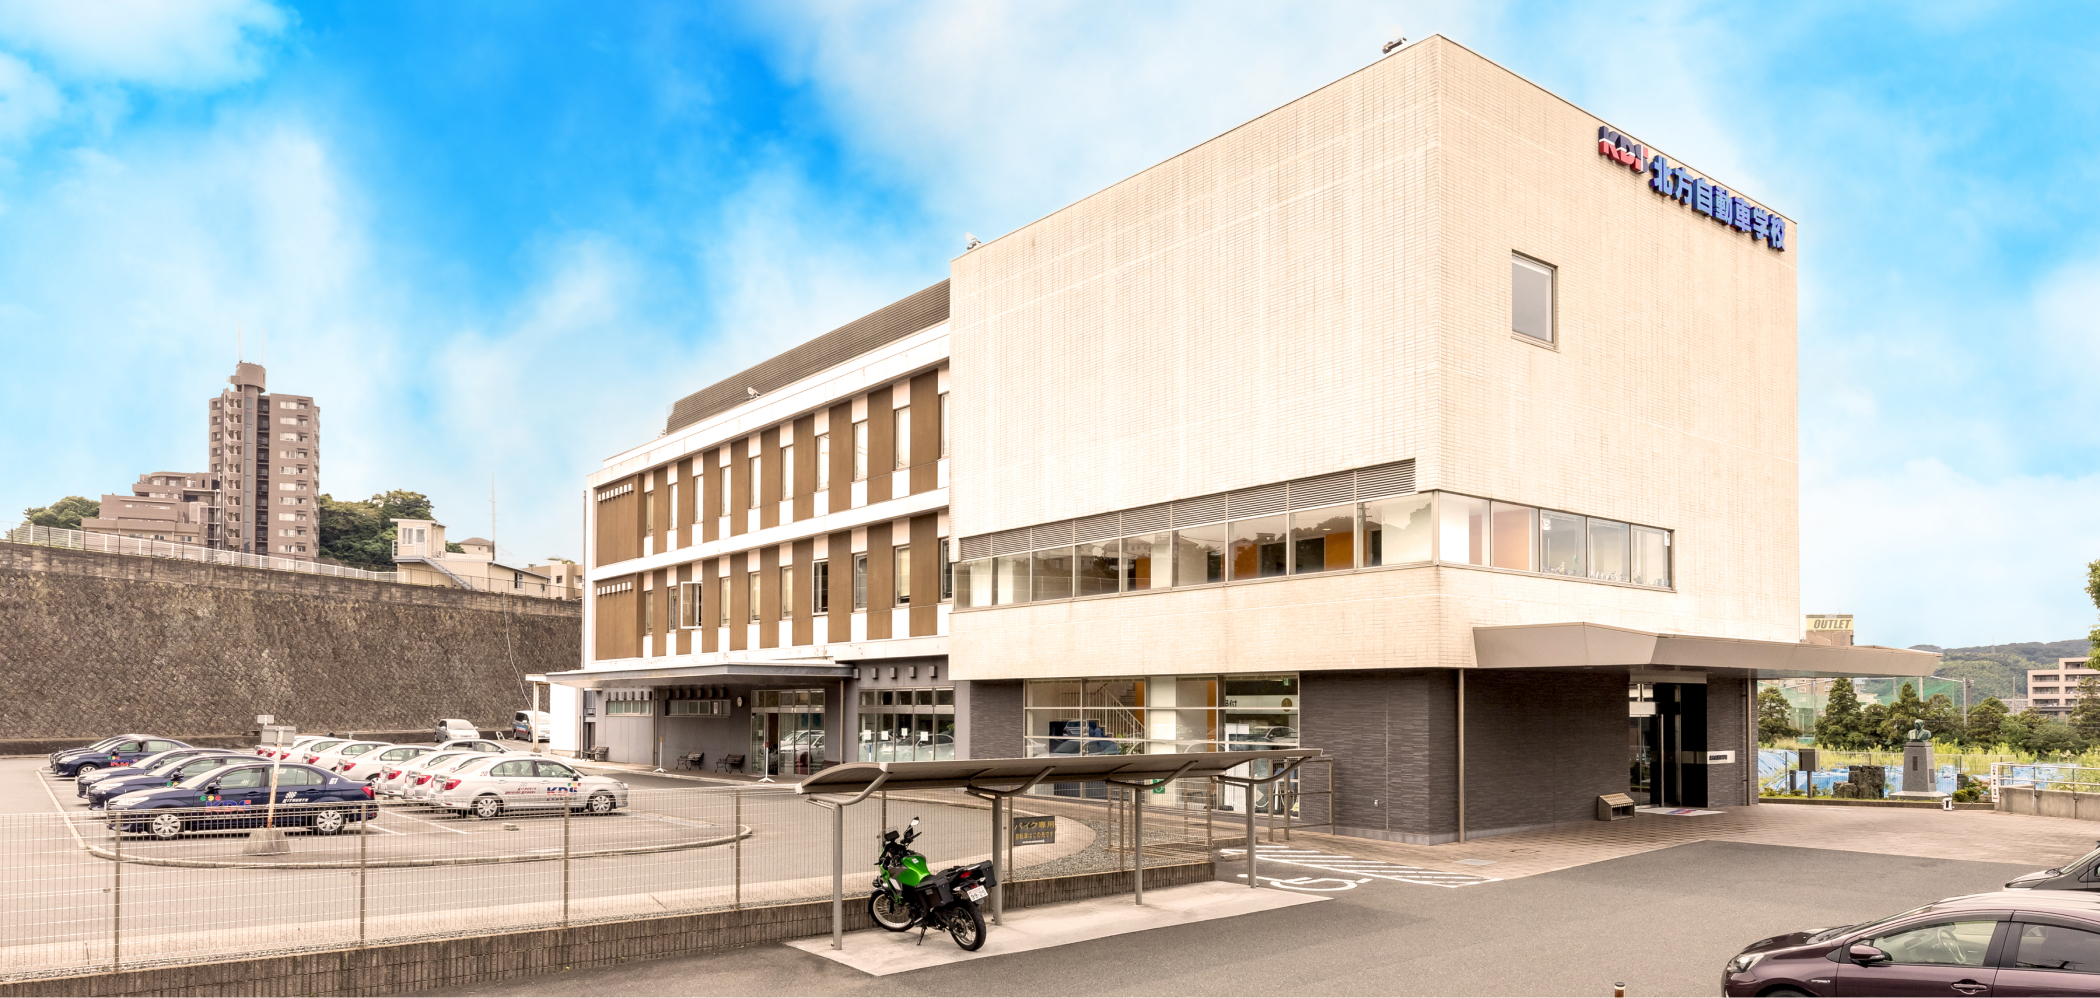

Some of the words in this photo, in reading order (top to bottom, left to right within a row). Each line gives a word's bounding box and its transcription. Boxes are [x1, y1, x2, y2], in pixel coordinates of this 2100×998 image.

[1649, 155, 1786, 252] 北方自動車学校
[1813, 619, 1851, 629] OUTLET
[1014, 820, 1055, 830] バイク専用
